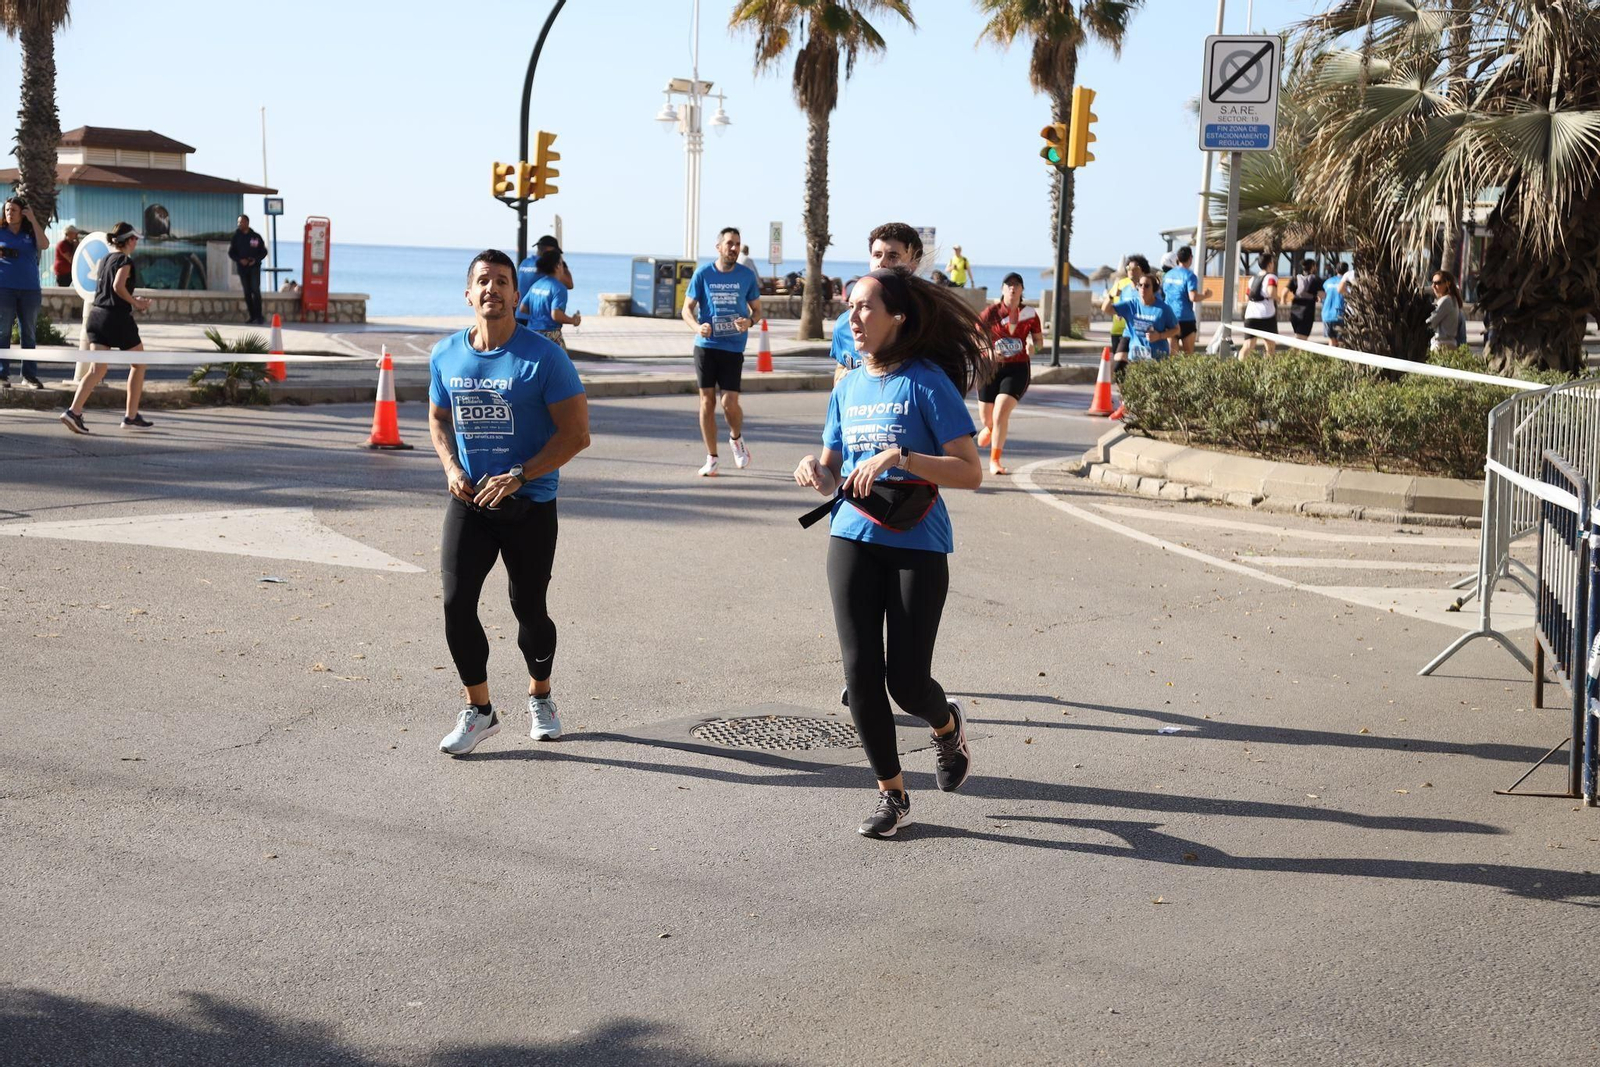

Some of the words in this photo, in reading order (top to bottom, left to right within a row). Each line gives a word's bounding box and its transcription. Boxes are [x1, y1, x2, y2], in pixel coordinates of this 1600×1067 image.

[449, 377, 513, 390] mayoral
[460, 407, 506, 419] 2023
[846, 400, 909, 418] mayoral
[846, 433, 897, 444] MAKES
